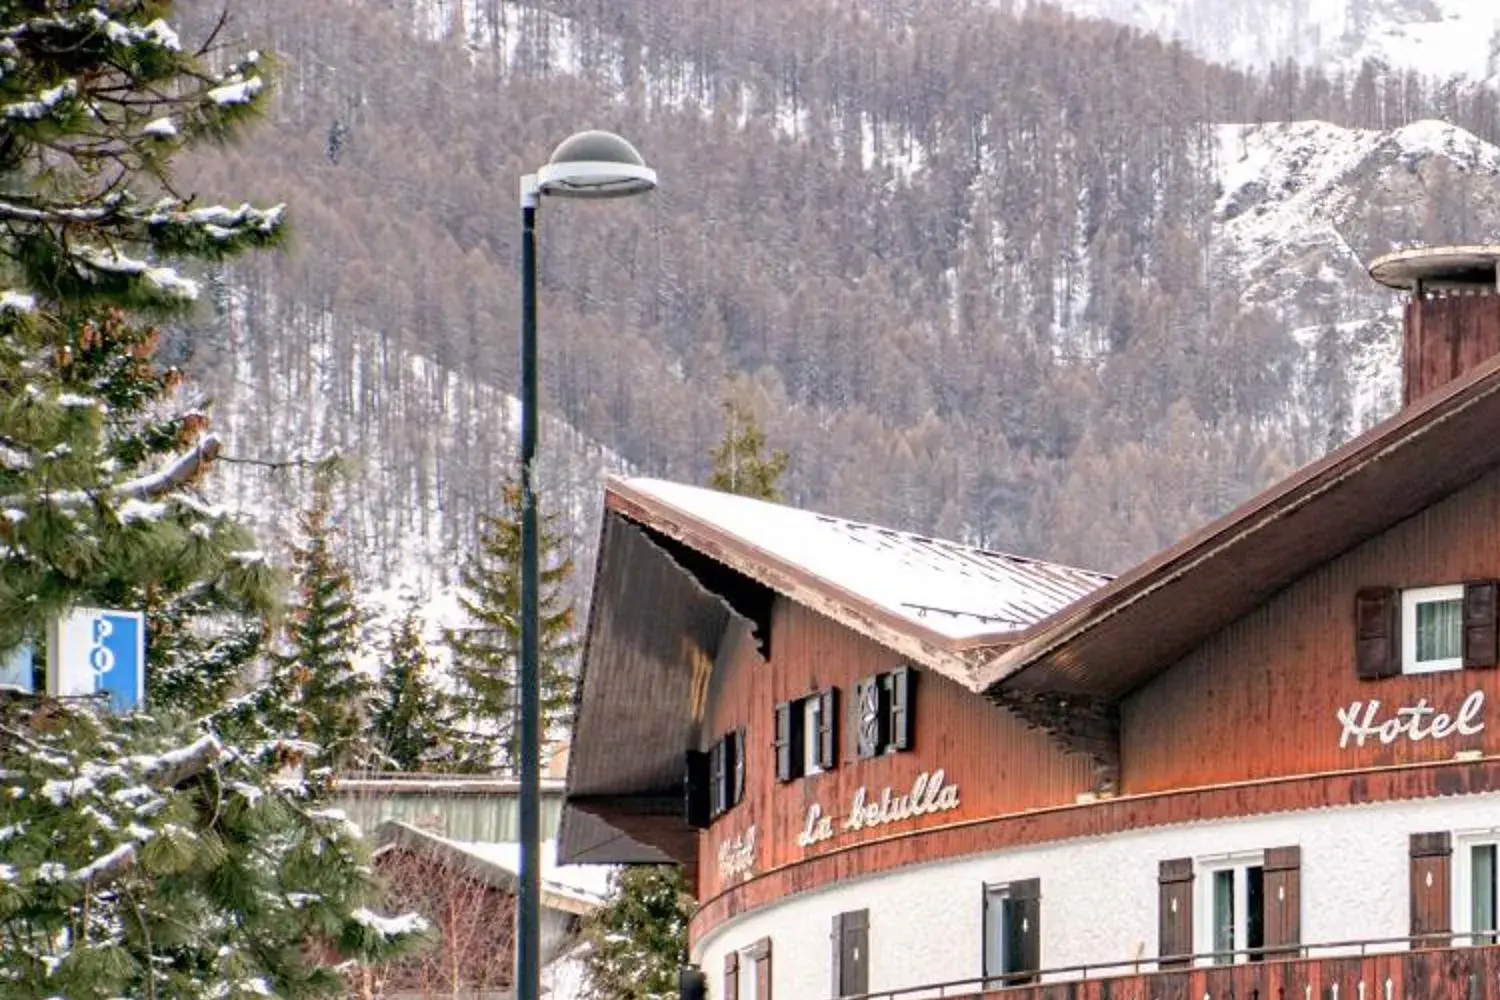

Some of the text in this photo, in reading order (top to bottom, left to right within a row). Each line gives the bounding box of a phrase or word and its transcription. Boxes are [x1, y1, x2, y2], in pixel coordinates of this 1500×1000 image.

[1337, 690, 1486, 748] Hotel
[796, 768, 960, 846] La betulla
